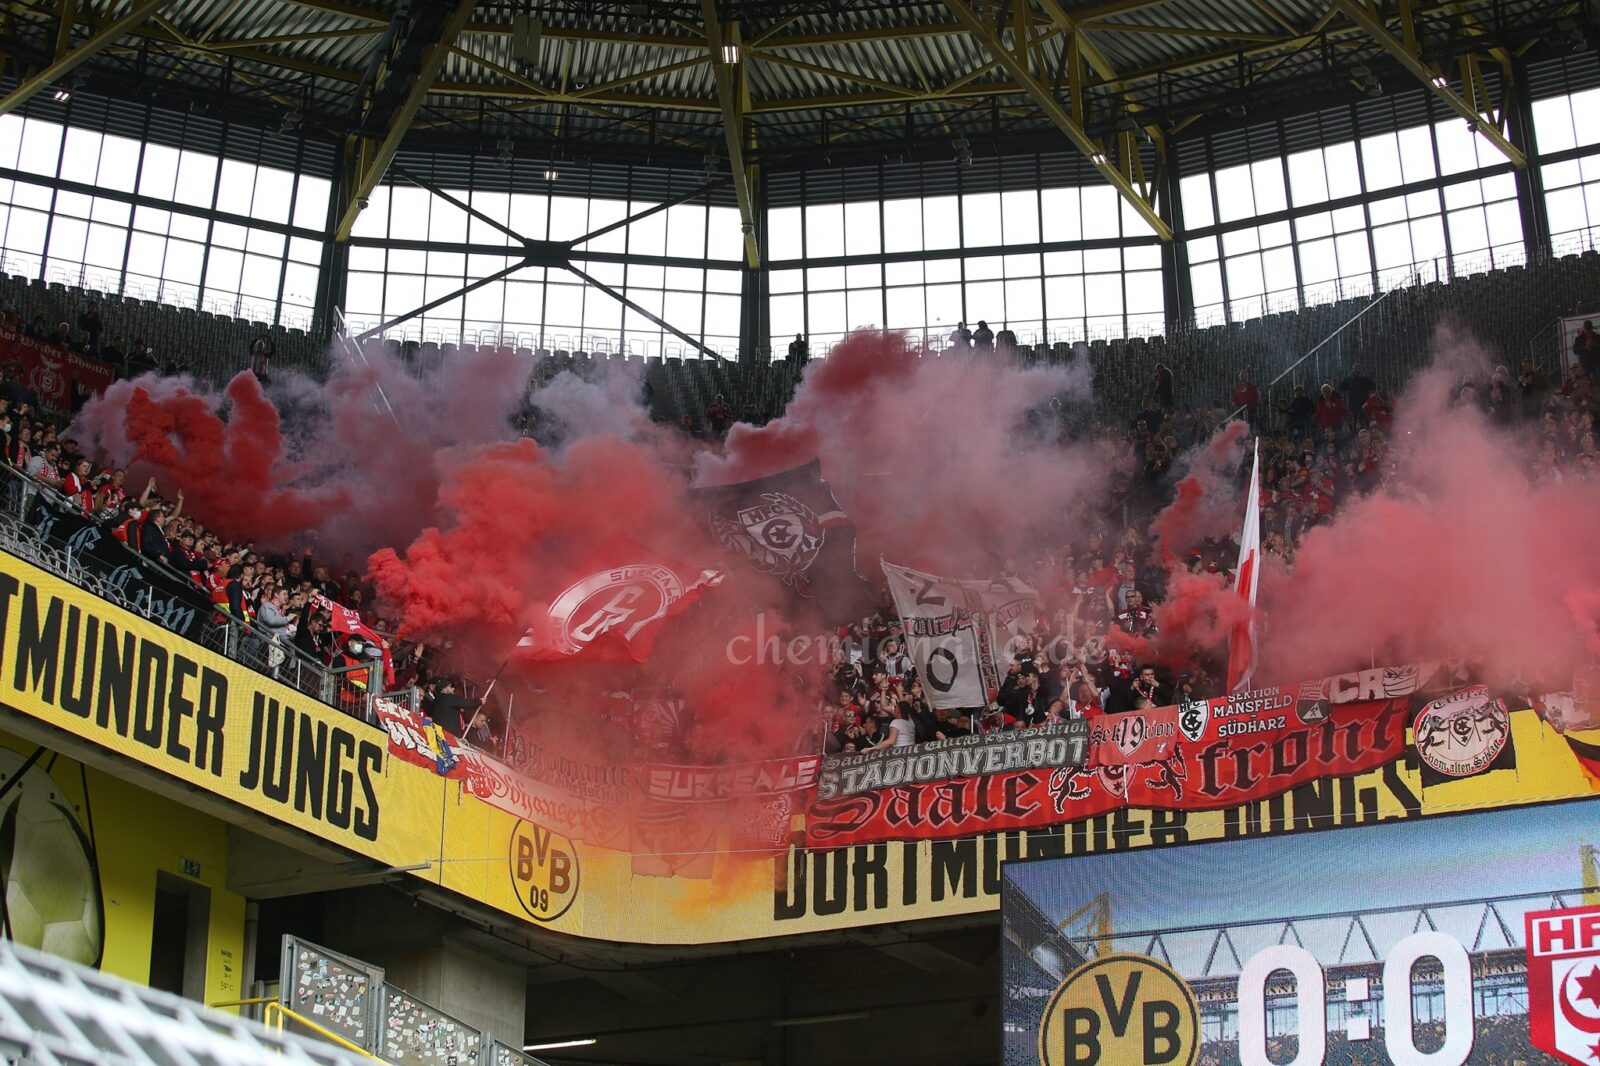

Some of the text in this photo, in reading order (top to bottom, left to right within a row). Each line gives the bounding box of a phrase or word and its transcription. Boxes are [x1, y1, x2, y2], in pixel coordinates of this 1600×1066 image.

[1208, 686, 1280, 702] SEKTION
[1213, 694, 1293, 719] MANSFELD
[1218, 715, 1286, 738] SÜDHARZ
[240, 691, 382, 842] JUNGS
[649, 759, 818, 798] SURREALE
[808, 698, 1400, 839] Saale front
[817, 735, 1088, 800] STADIONVERBOT
[1429, 753, 1447, 770] vom
[1450, 762, 1471, 773] alten
[517, 823, 572, 895] BVB
[530, 885, 549, 912] 09
[1064, 971, 1181, 1066] BVB
[1238, 931, 1475, 1066] 0:0
